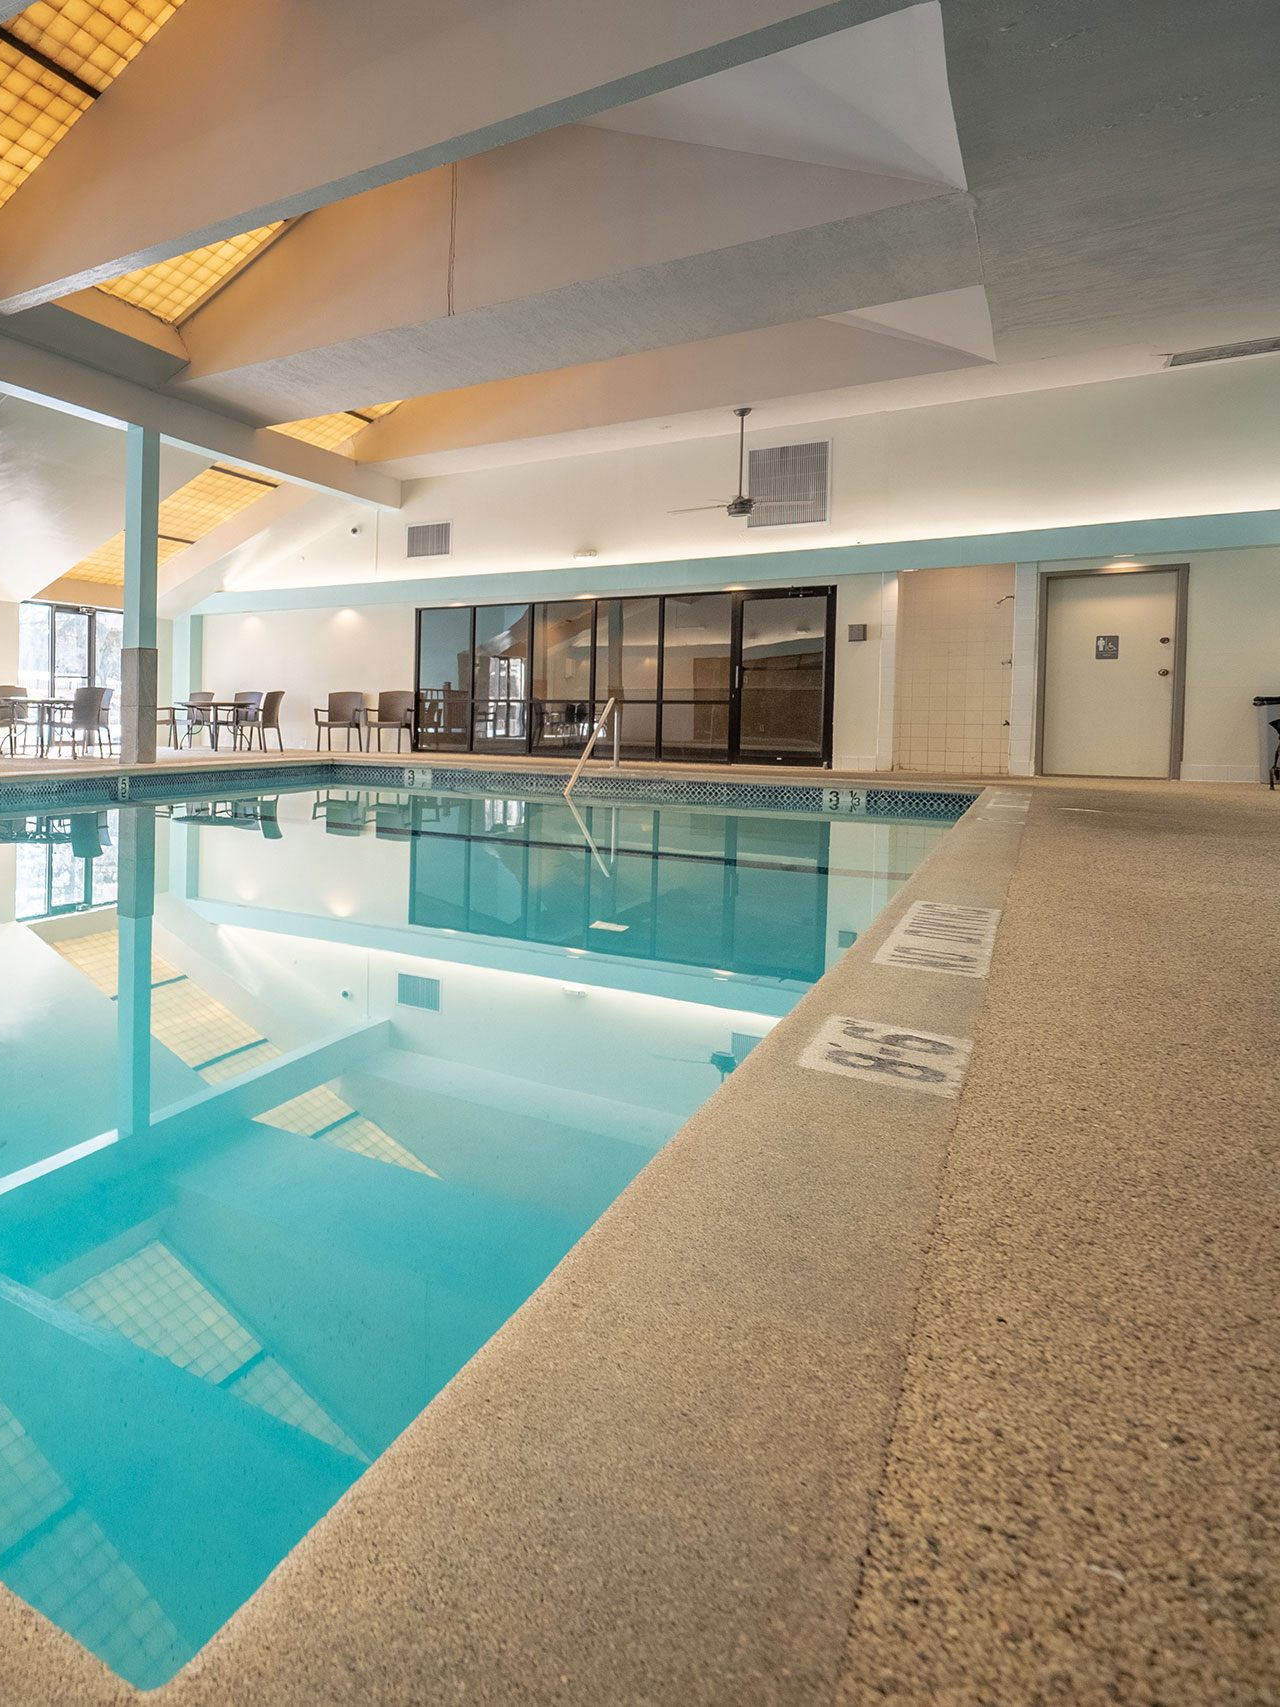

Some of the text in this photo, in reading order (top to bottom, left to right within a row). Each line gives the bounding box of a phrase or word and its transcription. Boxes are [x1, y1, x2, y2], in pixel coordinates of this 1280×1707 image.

[121, 778, 127, 790] 5
[829, 790, 840, 802] 3
[903, 903, 991, 945] DIVING
